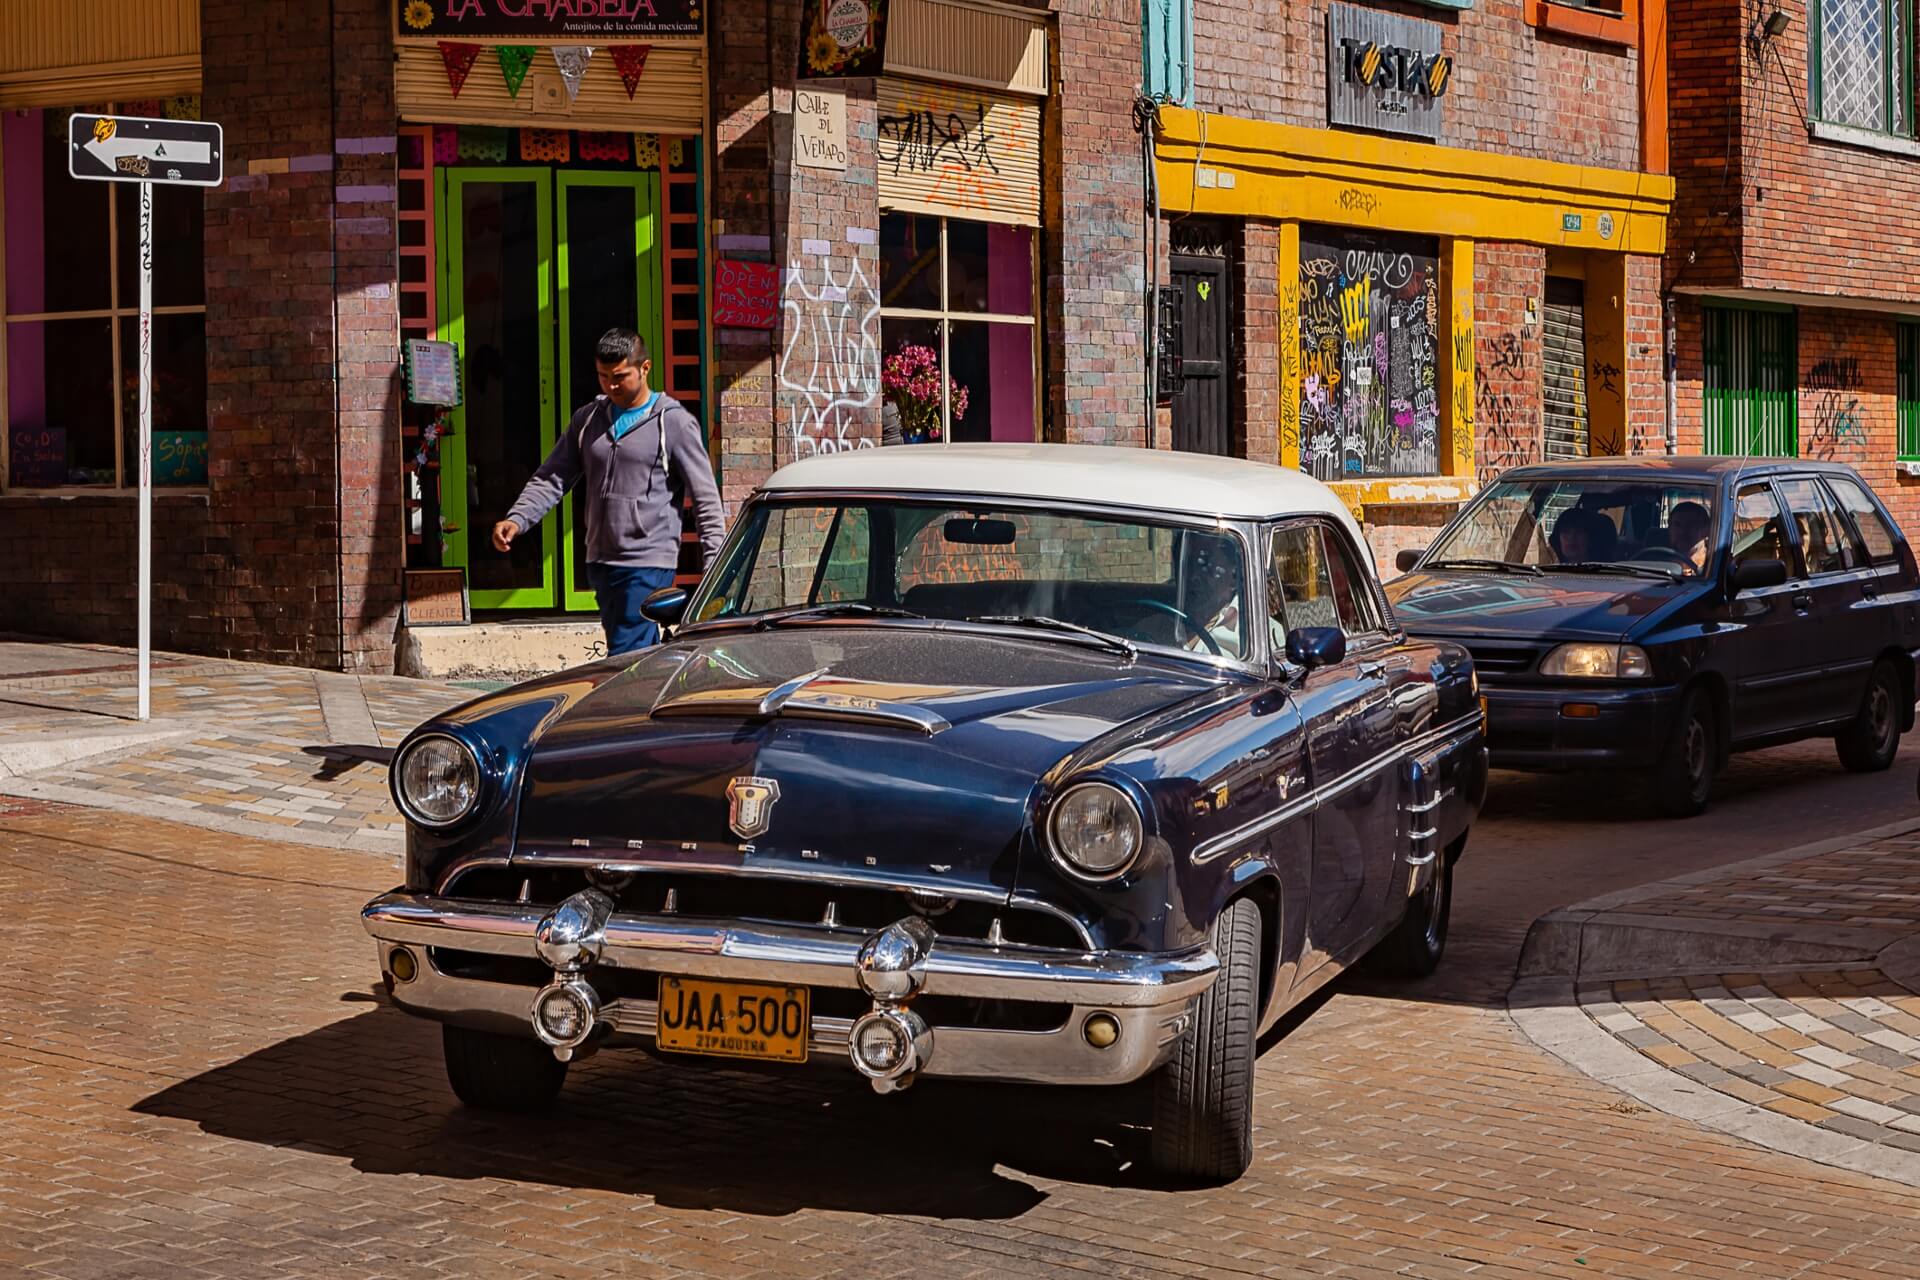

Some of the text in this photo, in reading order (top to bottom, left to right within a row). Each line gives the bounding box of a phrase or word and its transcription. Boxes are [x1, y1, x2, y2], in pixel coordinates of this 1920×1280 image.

[562, 22, 698, 32] Antojitos de la comida mexicana
[721, 270, 772, 289] OPEN
[663, 989, 803, 1039] JAA 500
